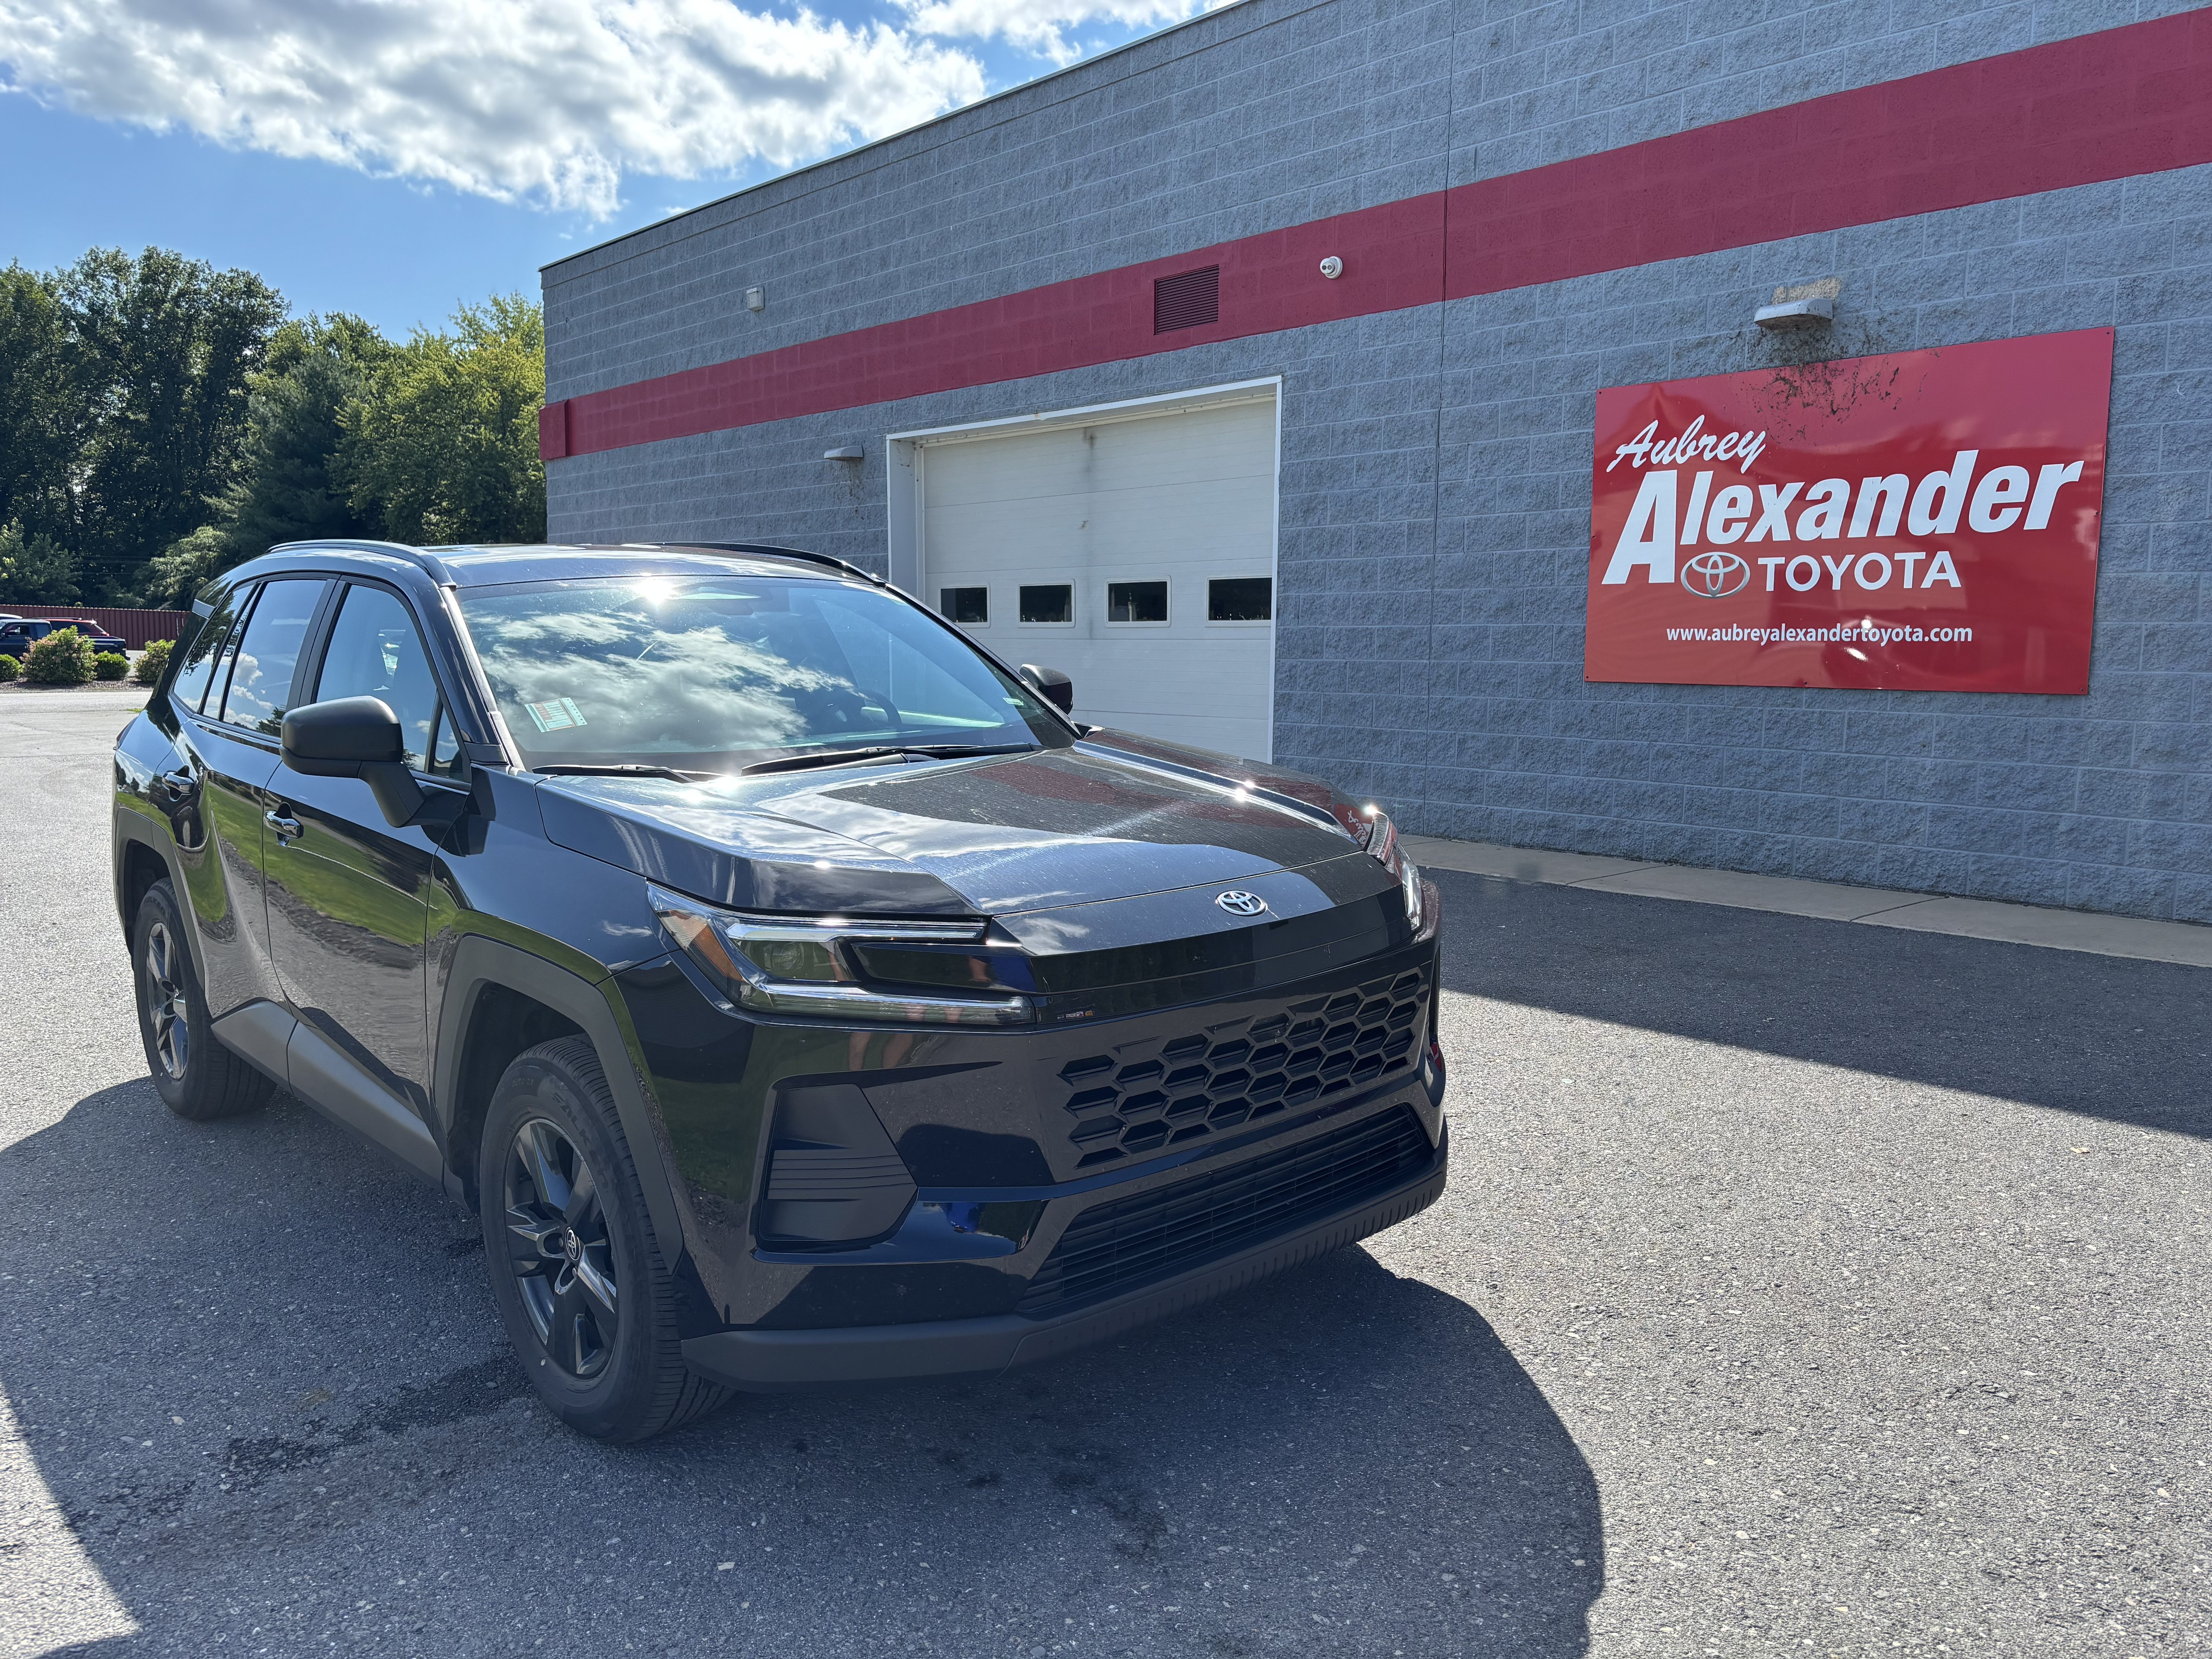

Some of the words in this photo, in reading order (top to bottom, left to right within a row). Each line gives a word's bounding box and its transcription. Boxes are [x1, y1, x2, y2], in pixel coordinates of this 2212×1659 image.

[1606, 414, 1766, 474] Aubrey
[1602, 449, 2084, 585] Alexander
[1758, 551, 1961, 592] TOYOTA
[1666, 622, 1972, 647] www.aubreyalexandertoyota.com
